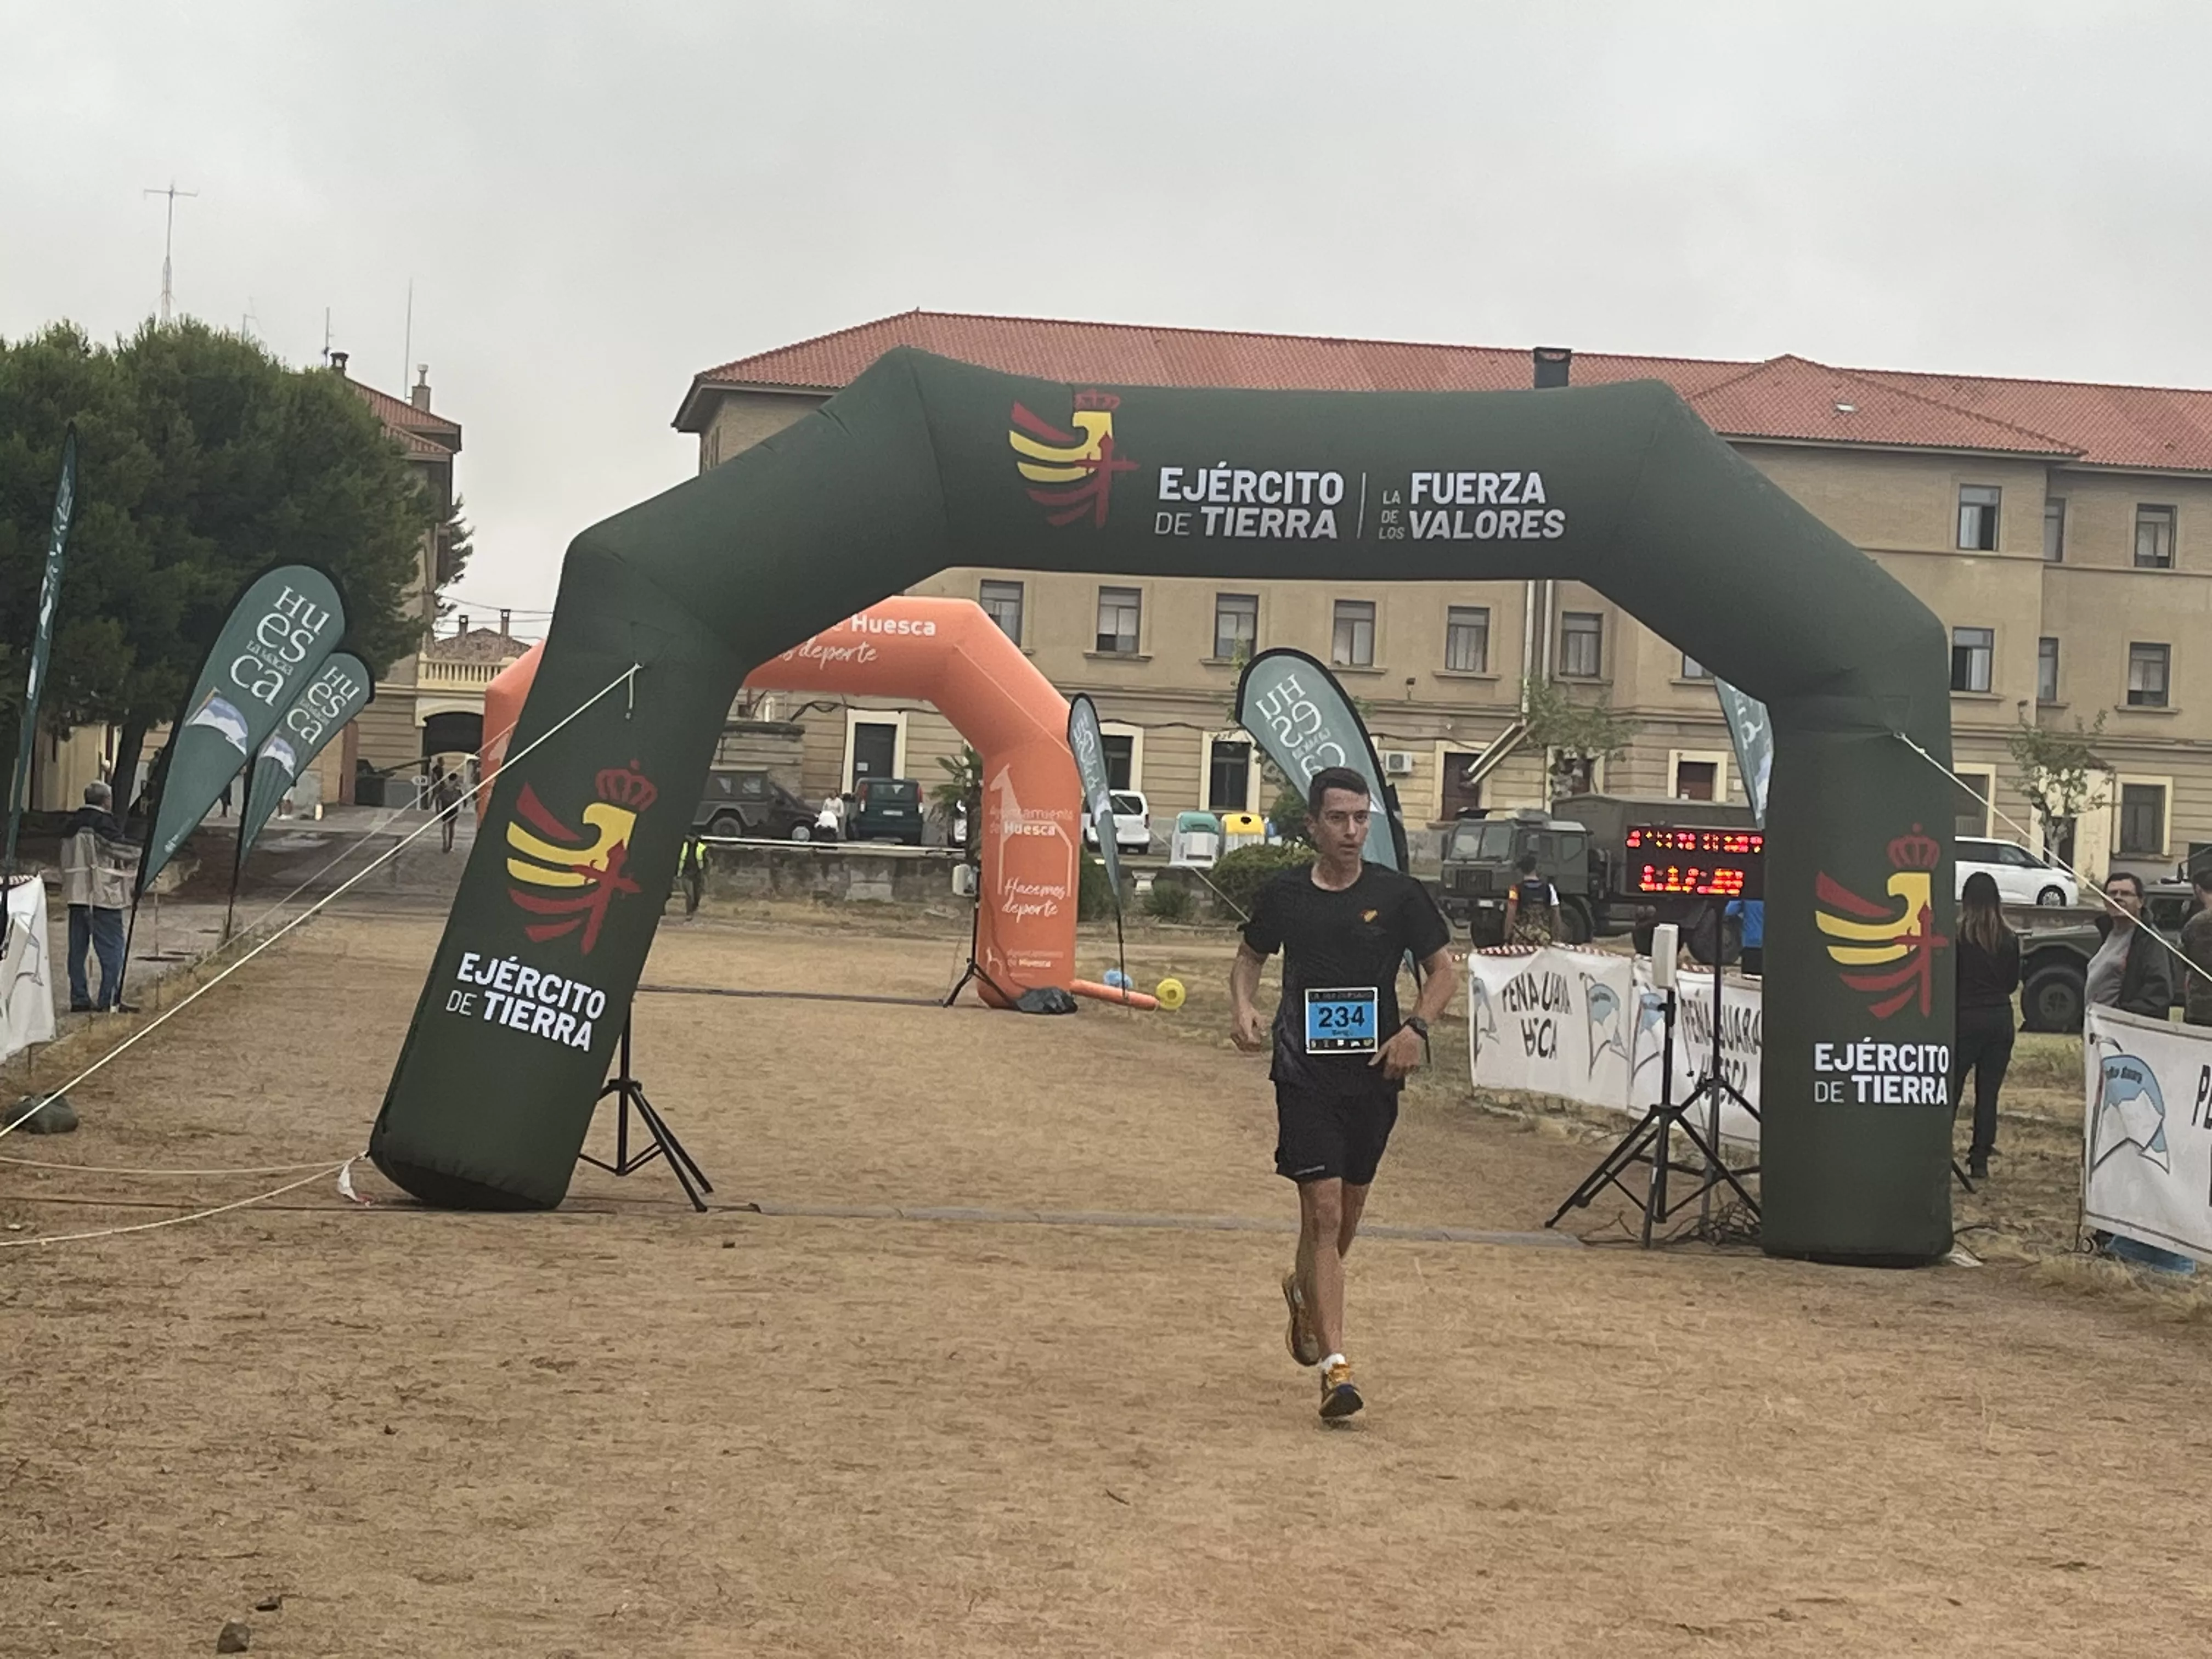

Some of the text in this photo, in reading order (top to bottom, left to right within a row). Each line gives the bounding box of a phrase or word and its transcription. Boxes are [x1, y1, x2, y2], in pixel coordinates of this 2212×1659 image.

[1159, 461, 1345, 506] EJÉRCITO
[1383, 490, 1401, 504] LA
[1410, 472, 1546, 505] FUERZA
[1154, 506, 1338, 539] DE TIERRA
[1381, 510, 1398, 524] DE
[1409, 509, 1566, 539] VALORES
[1378, 527, 1405, 540] LOS
[851, 613, 935, 636] Huesca
[798, 635, 878, 670] deporte
[1004, 821, 1056, 837] Huesca
[1002, 891, 1058, 923] deporte
[456, 951, 607, 1020] EJÉRCITO
[445, 990, 594, 1052] DE TIERRA
[1318, 1006, 1364, 1028] 234
[1814, 1036, 1949, 1074] EJÉRCITO
[1814, 1075, 1948, 1105] DE TIERRA
